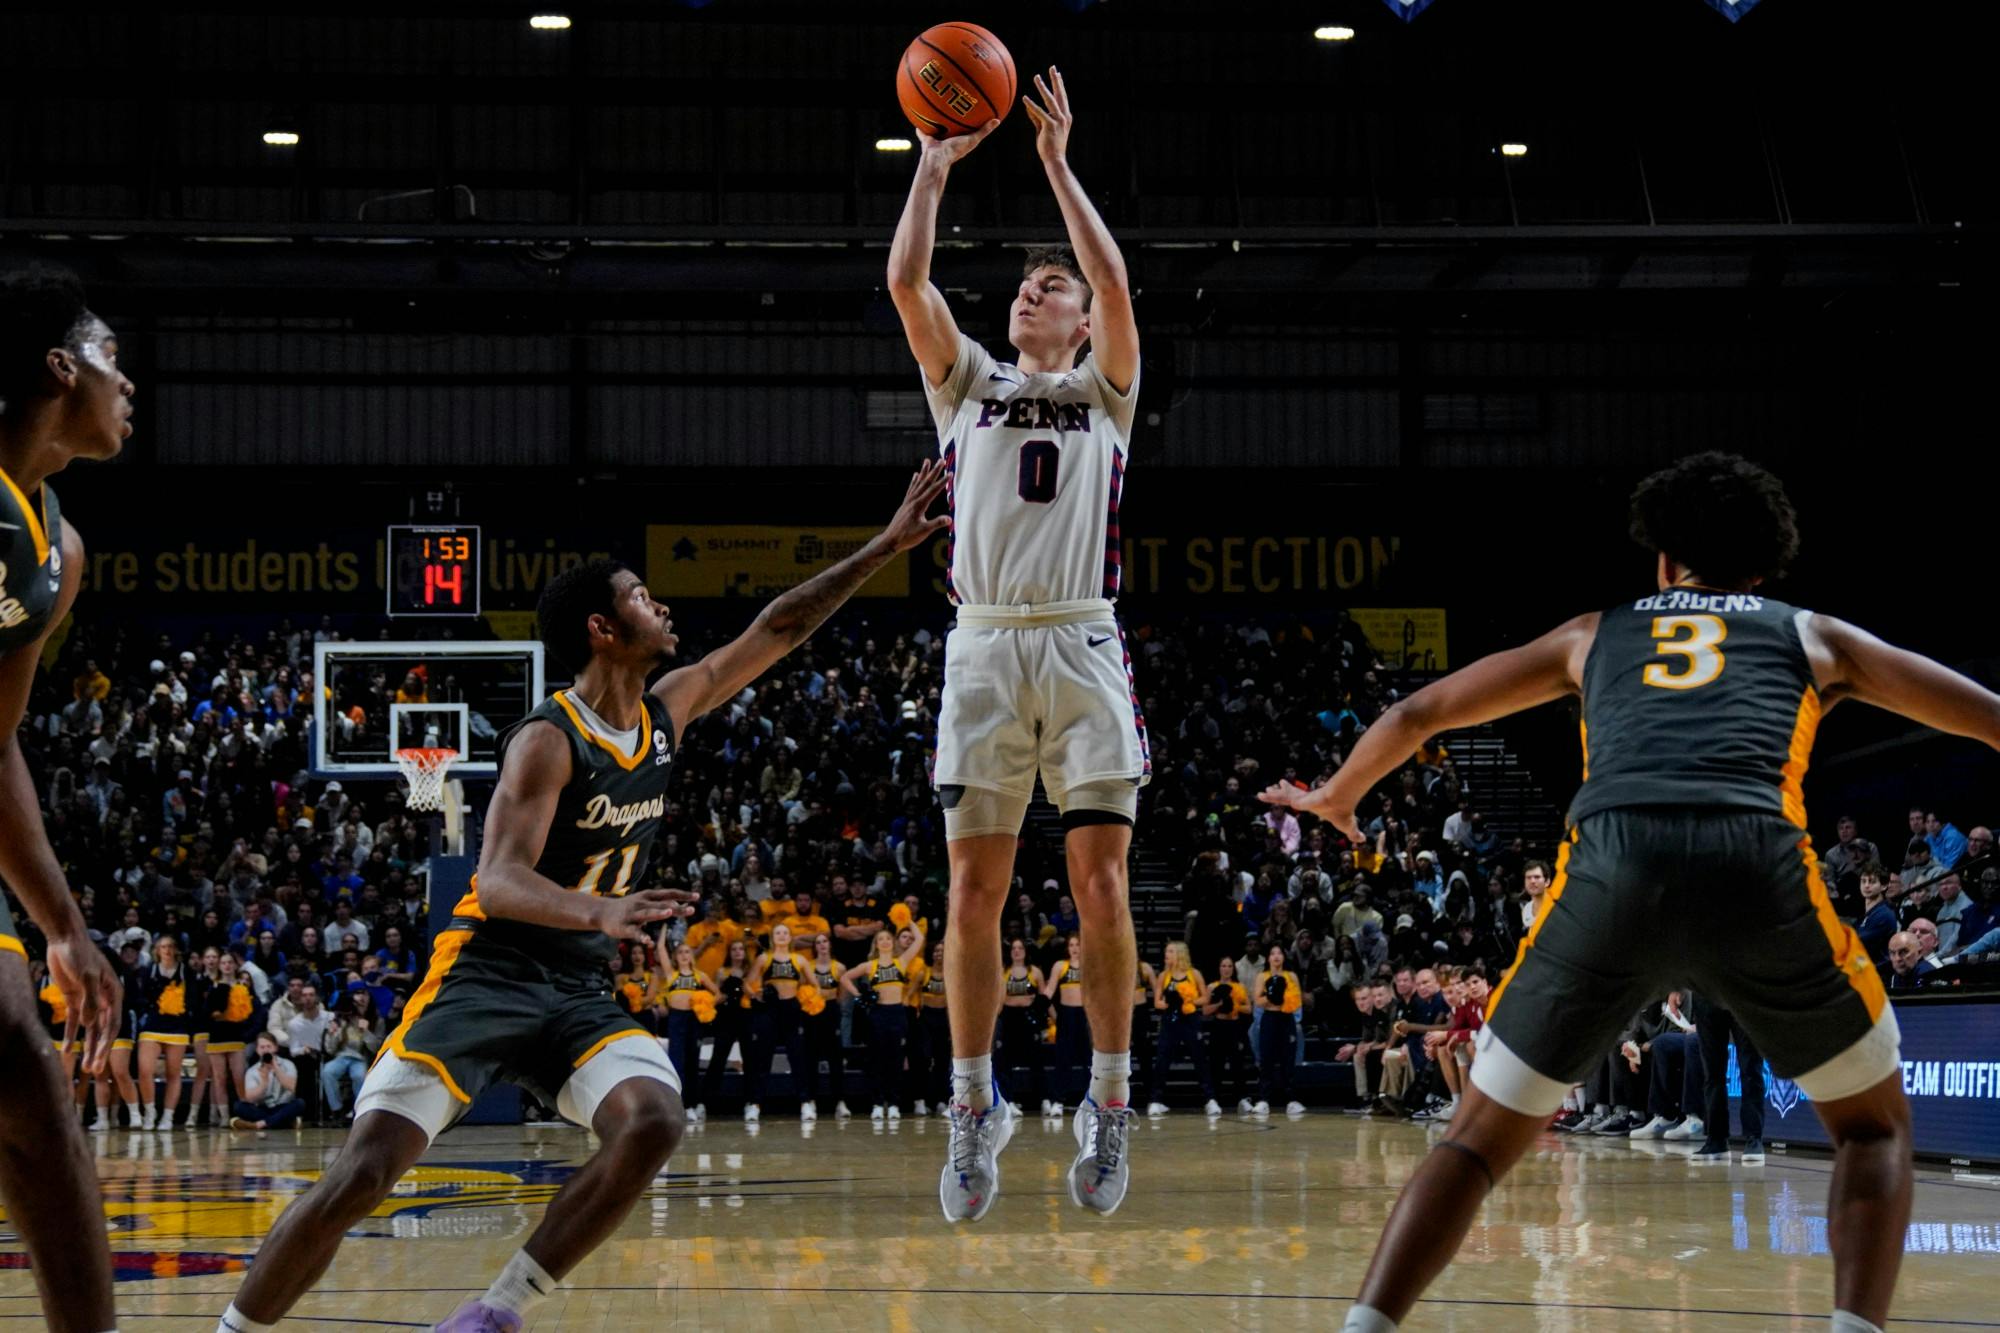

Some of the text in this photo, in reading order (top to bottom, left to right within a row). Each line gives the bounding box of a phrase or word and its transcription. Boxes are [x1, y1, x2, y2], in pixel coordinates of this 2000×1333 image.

[919, 61, 975, 117] ELITE
[976, 398, 1091, 432] PENN
[1018, 440, 1059, 503] 0
[78, 551, 140, 592] re
[153, 538, 360, 592] students
[423, 563, 463, 606] 14
[1642, 613, 1729, 691] 3
[576, 793, 665, 839] Dragons
[576, 844, 641, 897] 11
[1898, 1060, 1940, 1097] EAM
